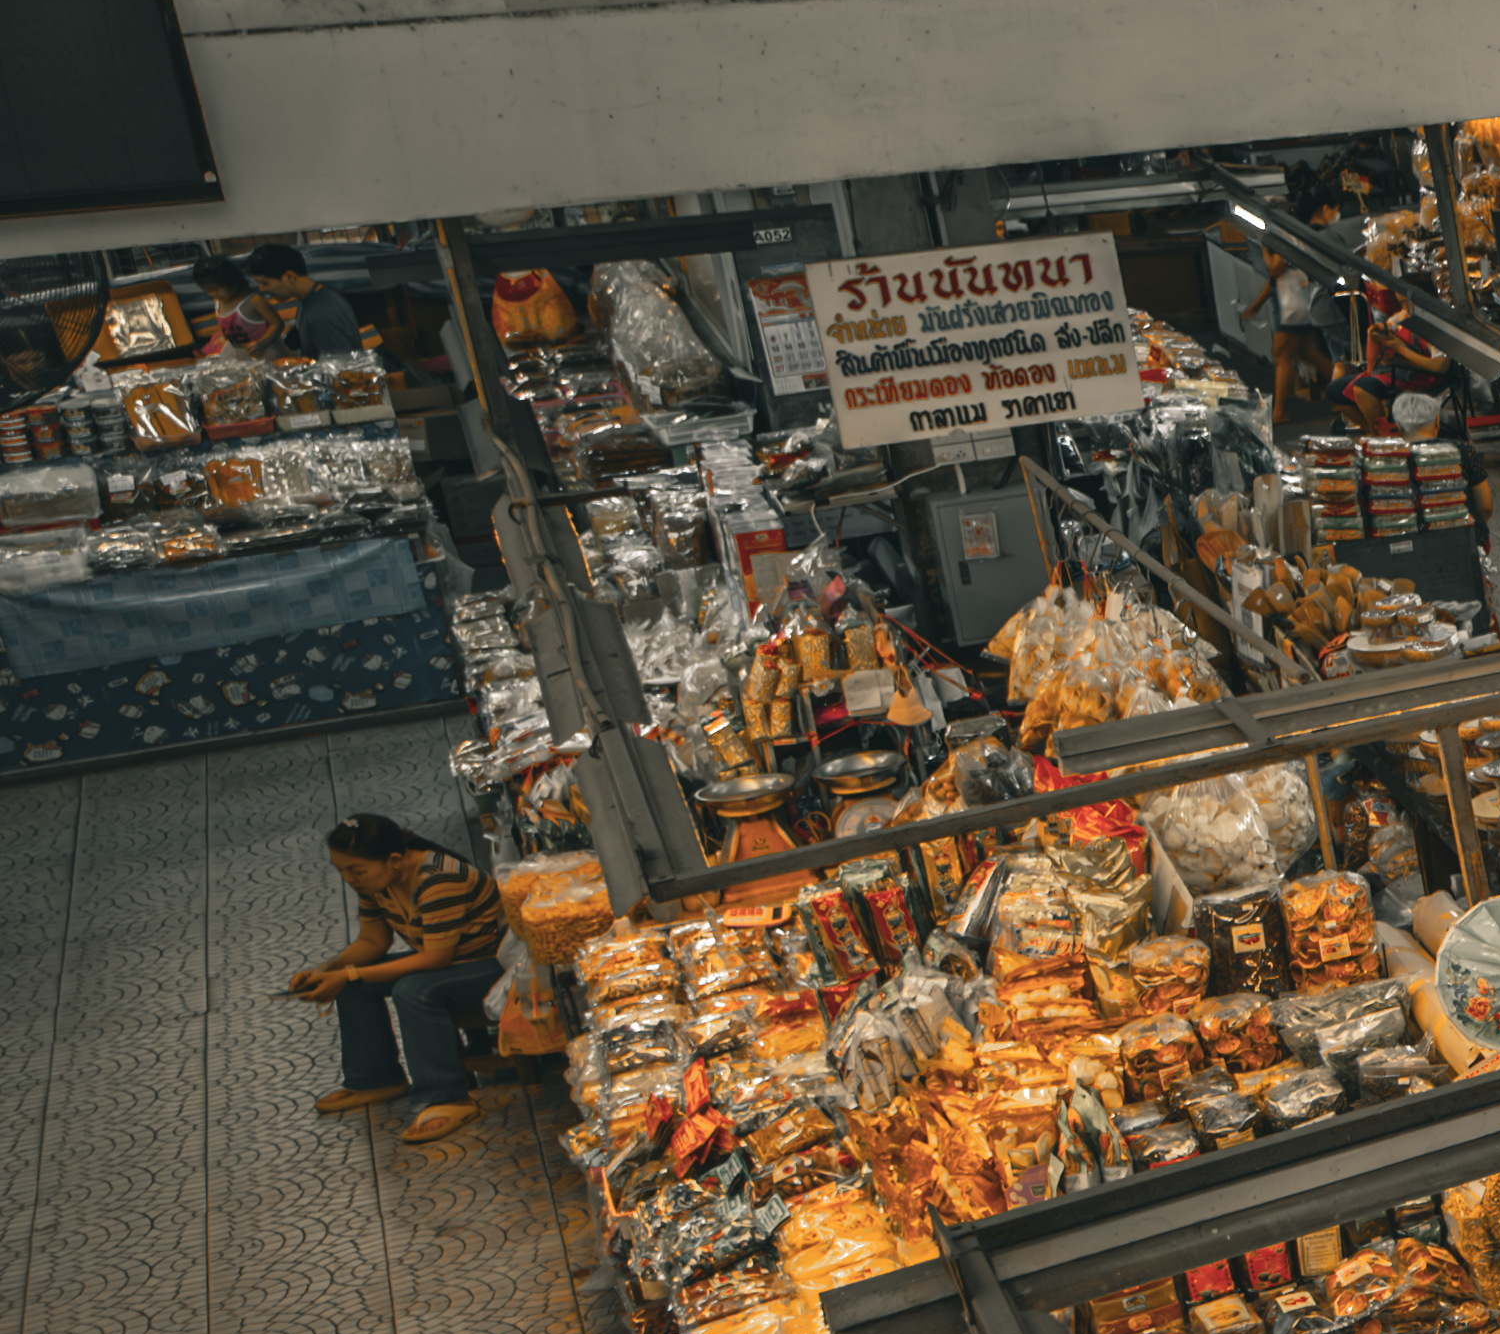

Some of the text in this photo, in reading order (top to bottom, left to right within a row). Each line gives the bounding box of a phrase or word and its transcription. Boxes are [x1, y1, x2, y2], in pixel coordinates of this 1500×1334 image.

[838, 253, 1094, 312] ร้านนันทนา
[826, 310, 907, 345] จำหน่าย
[835, 331, 1047, 378] สินค้าพื้นเมืองทุกชนิด
[1053, 319, 1126, 351] ส่ง-ปลีก
[844, 353, 1127, 410] กระเทียมดอง ท้อดอง แหนม
